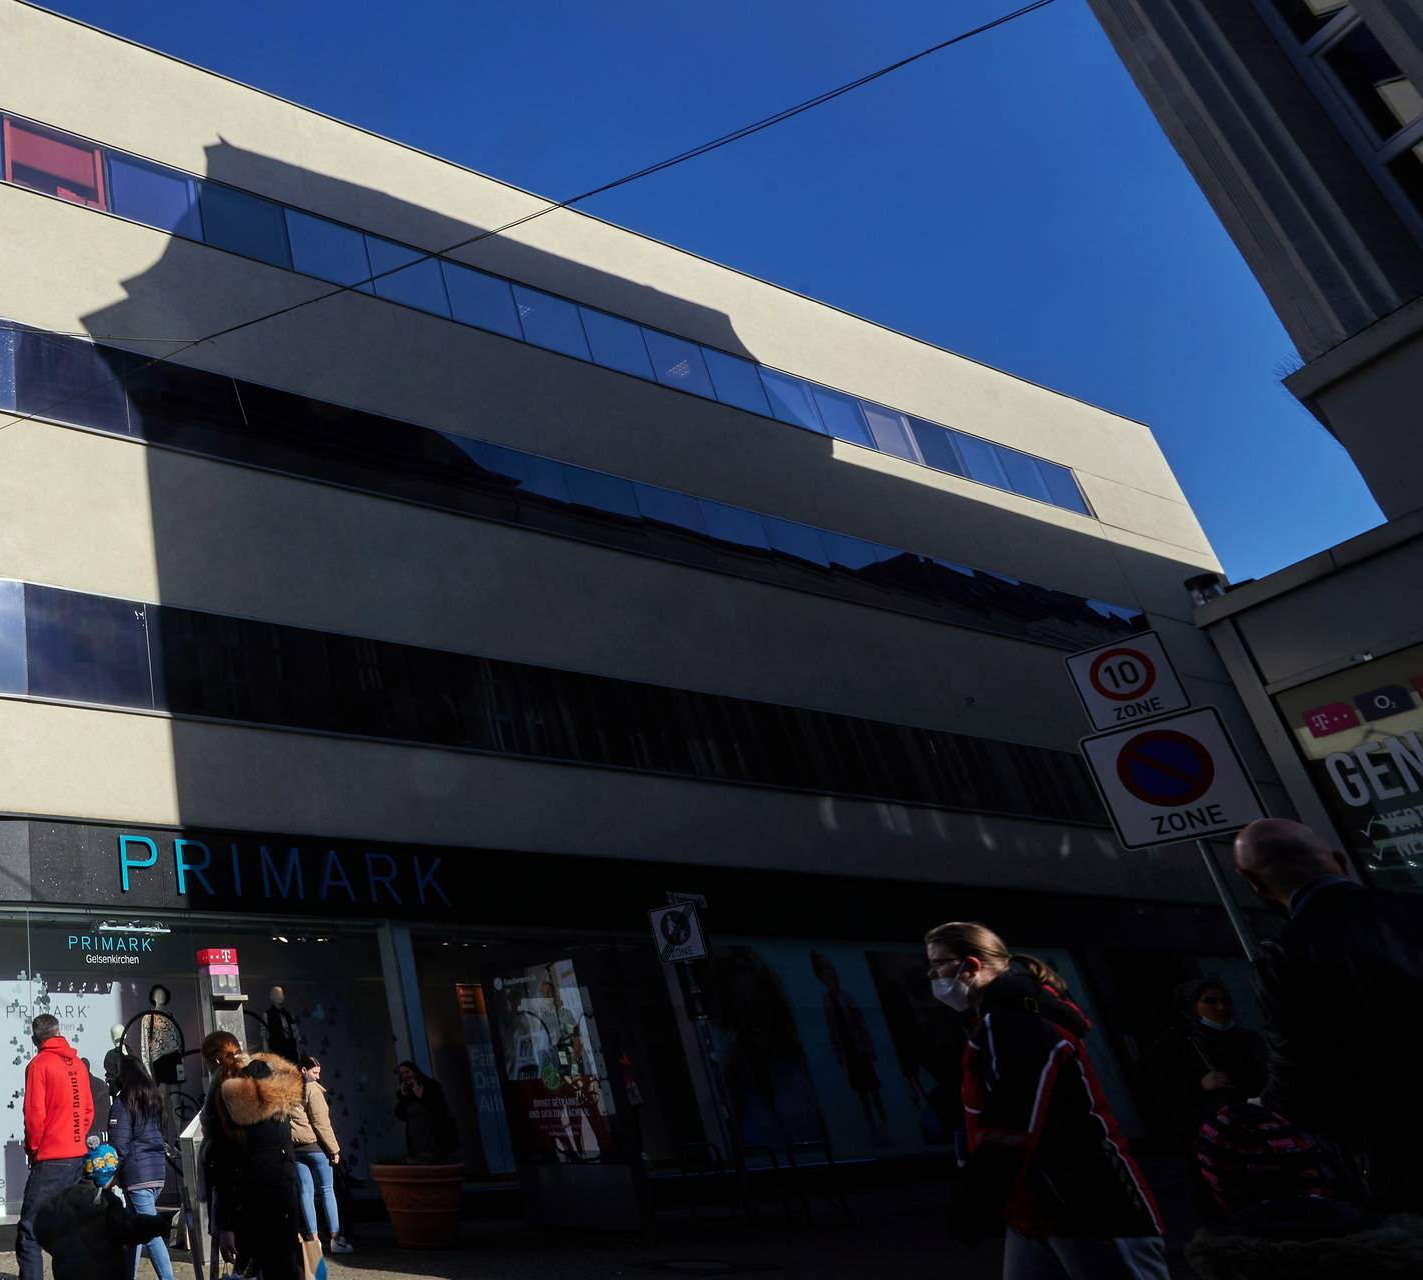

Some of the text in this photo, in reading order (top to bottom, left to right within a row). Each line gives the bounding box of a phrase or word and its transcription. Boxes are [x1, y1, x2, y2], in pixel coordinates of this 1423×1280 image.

[1103, 661, 1139, 688] 10
[1113, 697, 1164, 721] ZONE
[1151, 804, 1227, 835] ZONE
[118, 834, 453, 909] PRIMARK
[68, 935, 152, 951] PRIMARK
[86, 954, 139, 965] Gelsenkirchen
[71, 1078, 80, 1108] DAVID
[73, 1112, 81, 1142] CAMP
